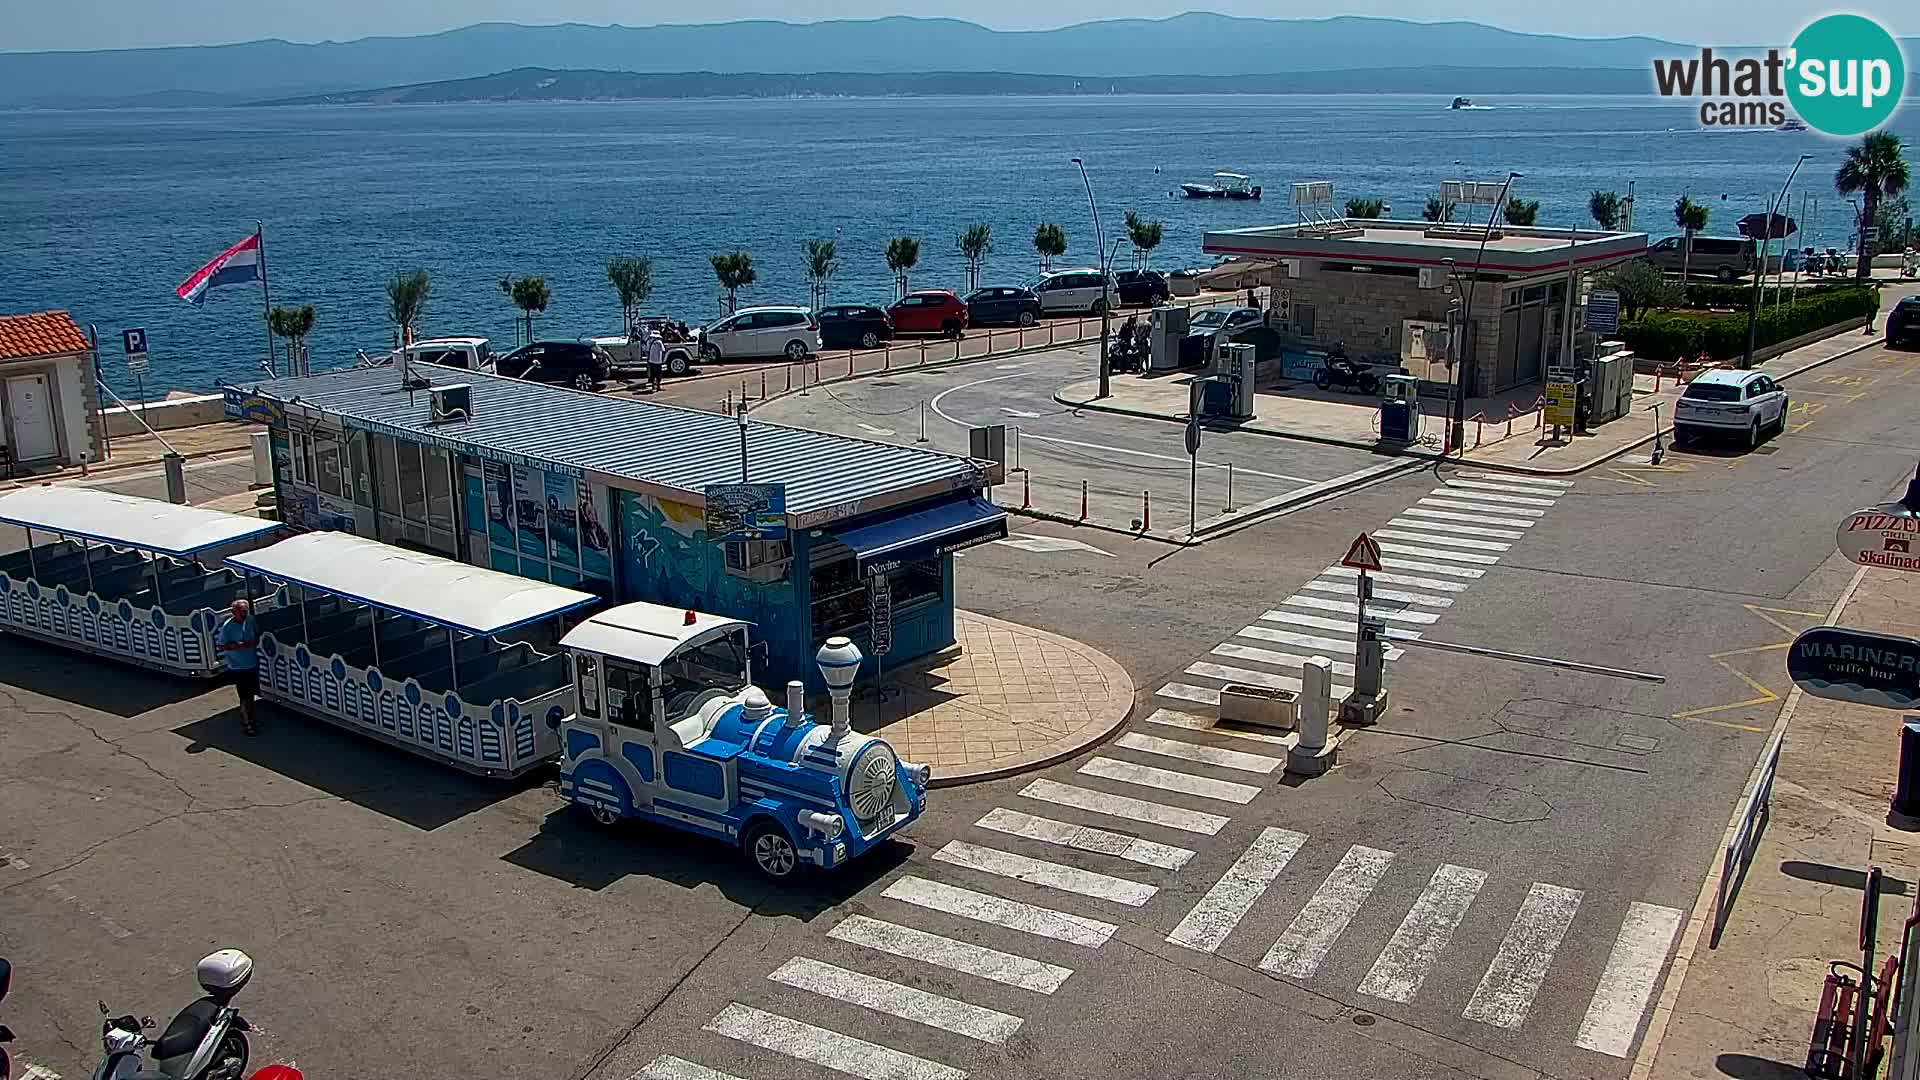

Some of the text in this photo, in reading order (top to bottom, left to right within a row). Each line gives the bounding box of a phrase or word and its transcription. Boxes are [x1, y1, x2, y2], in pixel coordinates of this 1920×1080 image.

[477, 447, 492, 458] BUS
[493, 450, 525, 465] STATION
[527, 458, 553, 472] TICKET
[554, 463, 581, 477] OFFICE
[1847, 515, 1920, 533] PIZZE
[1881, 530, 1918, 541] GRILL
[1800, 643, 1920, 674] MARINER
[1828, 663, 1896, 680] caffe bar
